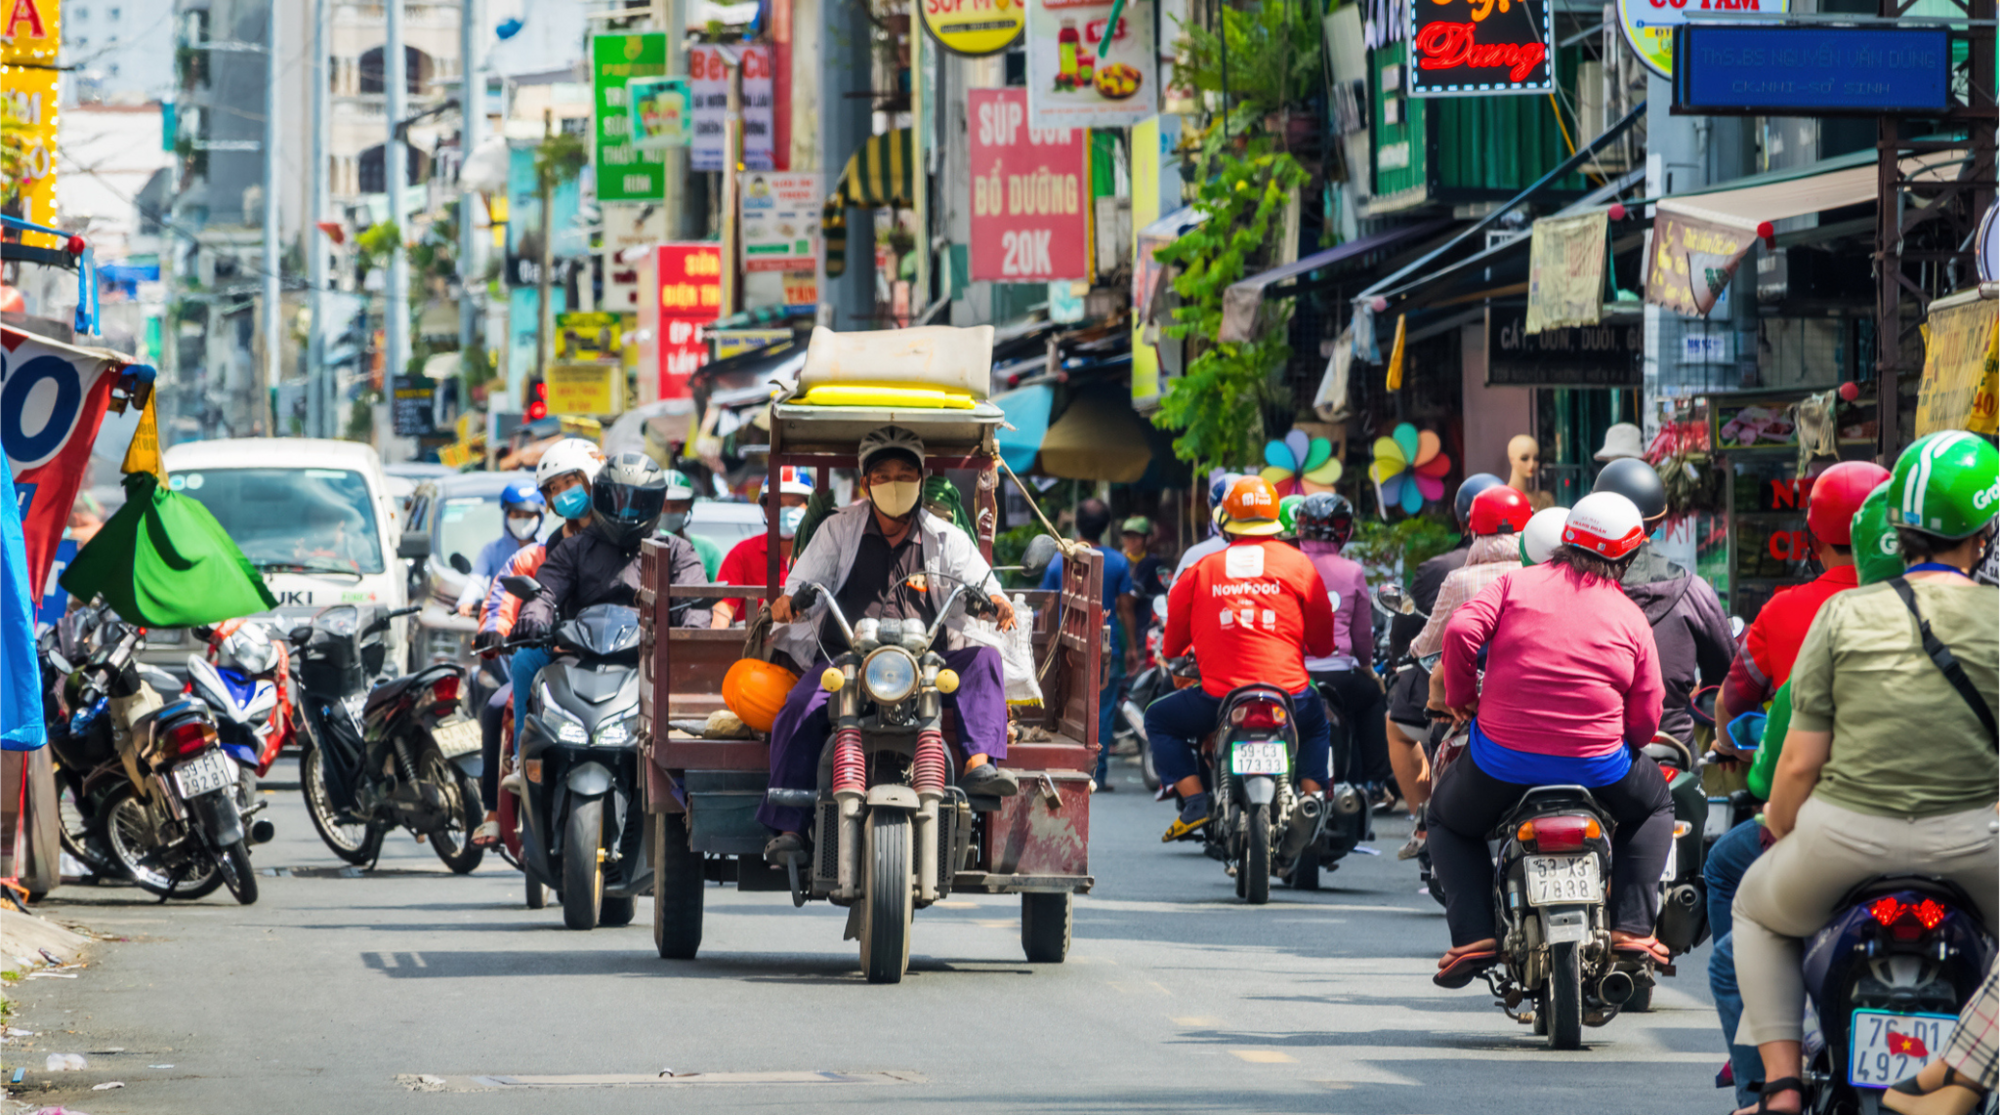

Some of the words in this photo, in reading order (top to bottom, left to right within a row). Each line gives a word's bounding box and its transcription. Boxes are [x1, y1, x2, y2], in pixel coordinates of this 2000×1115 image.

[979, 93, 1023, 147] SÚP
[974, 158, 1004, 217] BỔ
[1001, 229, 1053, 276] 20K
[1212, 580, 1281, 598] NowFood
[1240, 744, 1277, 758] 59-C3
[183, 769, 229, 796] 292.81
[1537, 856, 1587, 878] 53-X3
[1538, 878, 1590, 899] 7838
